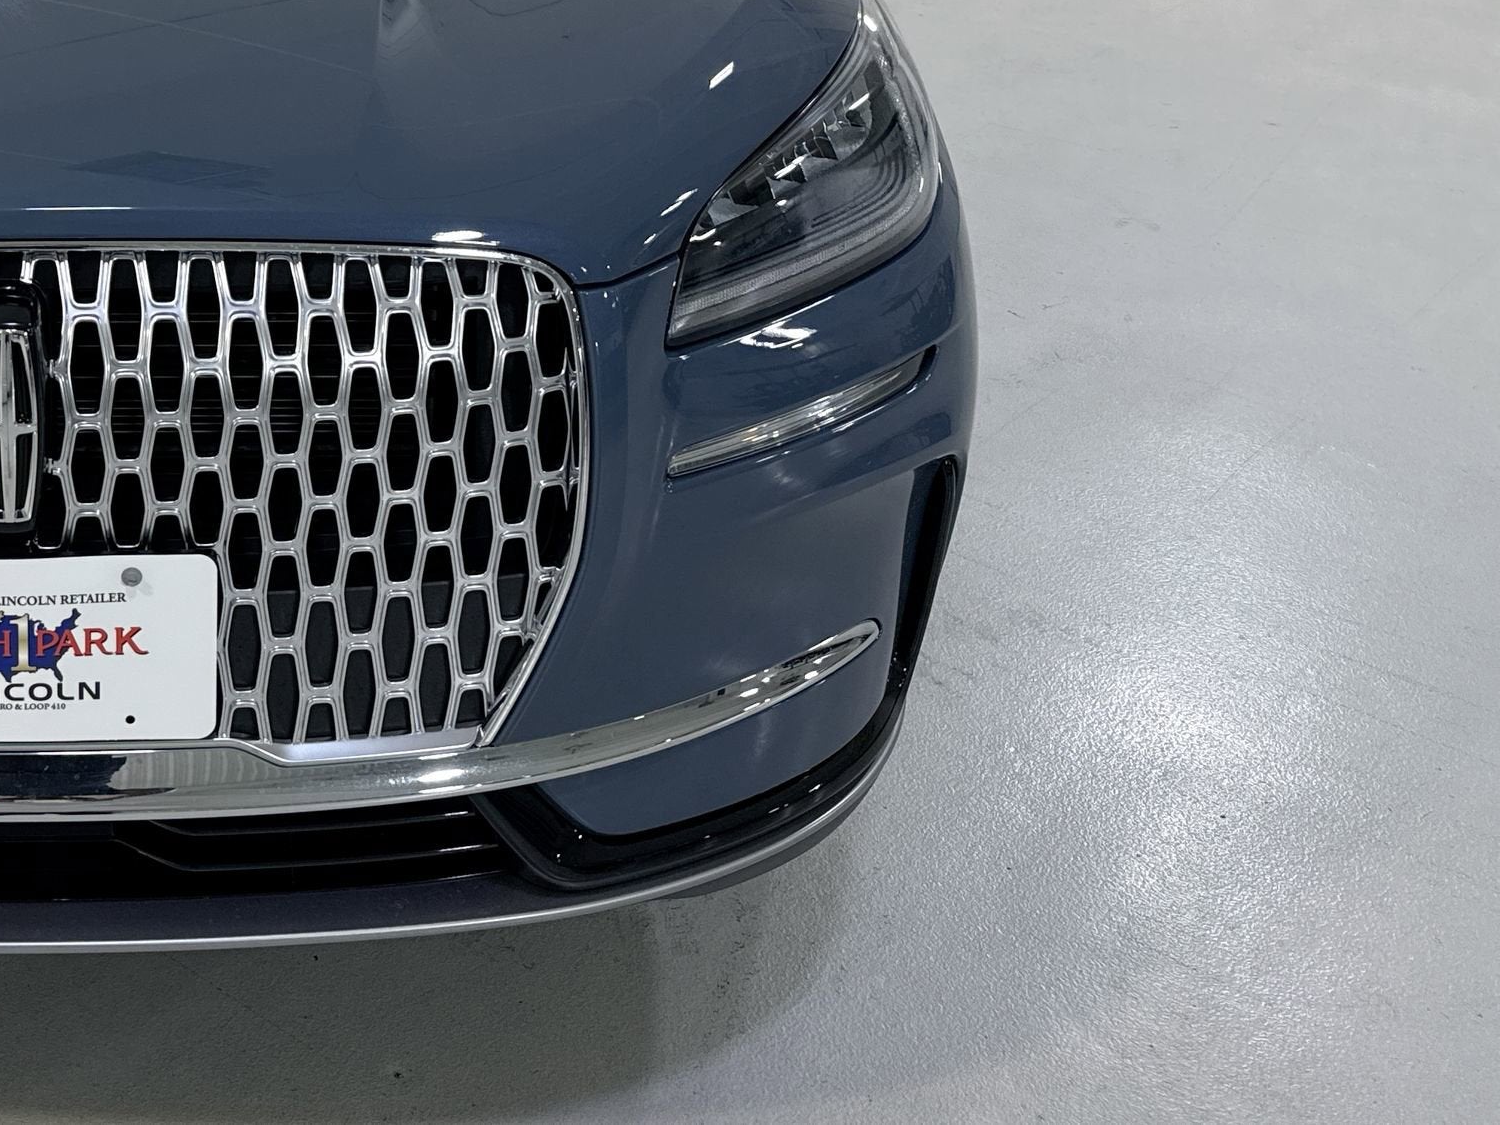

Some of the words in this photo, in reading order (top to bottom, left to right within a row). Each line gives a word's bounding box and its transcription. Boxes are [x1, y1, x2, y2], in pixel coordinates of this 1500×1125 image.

[60, 592, 127, 605] RETAILER
[35, 625, 149, 657] PARK
[14, 702, 23, 711] &
[24, 702, 50, 711] LOOP
[50, 702, 67, 711] 410
